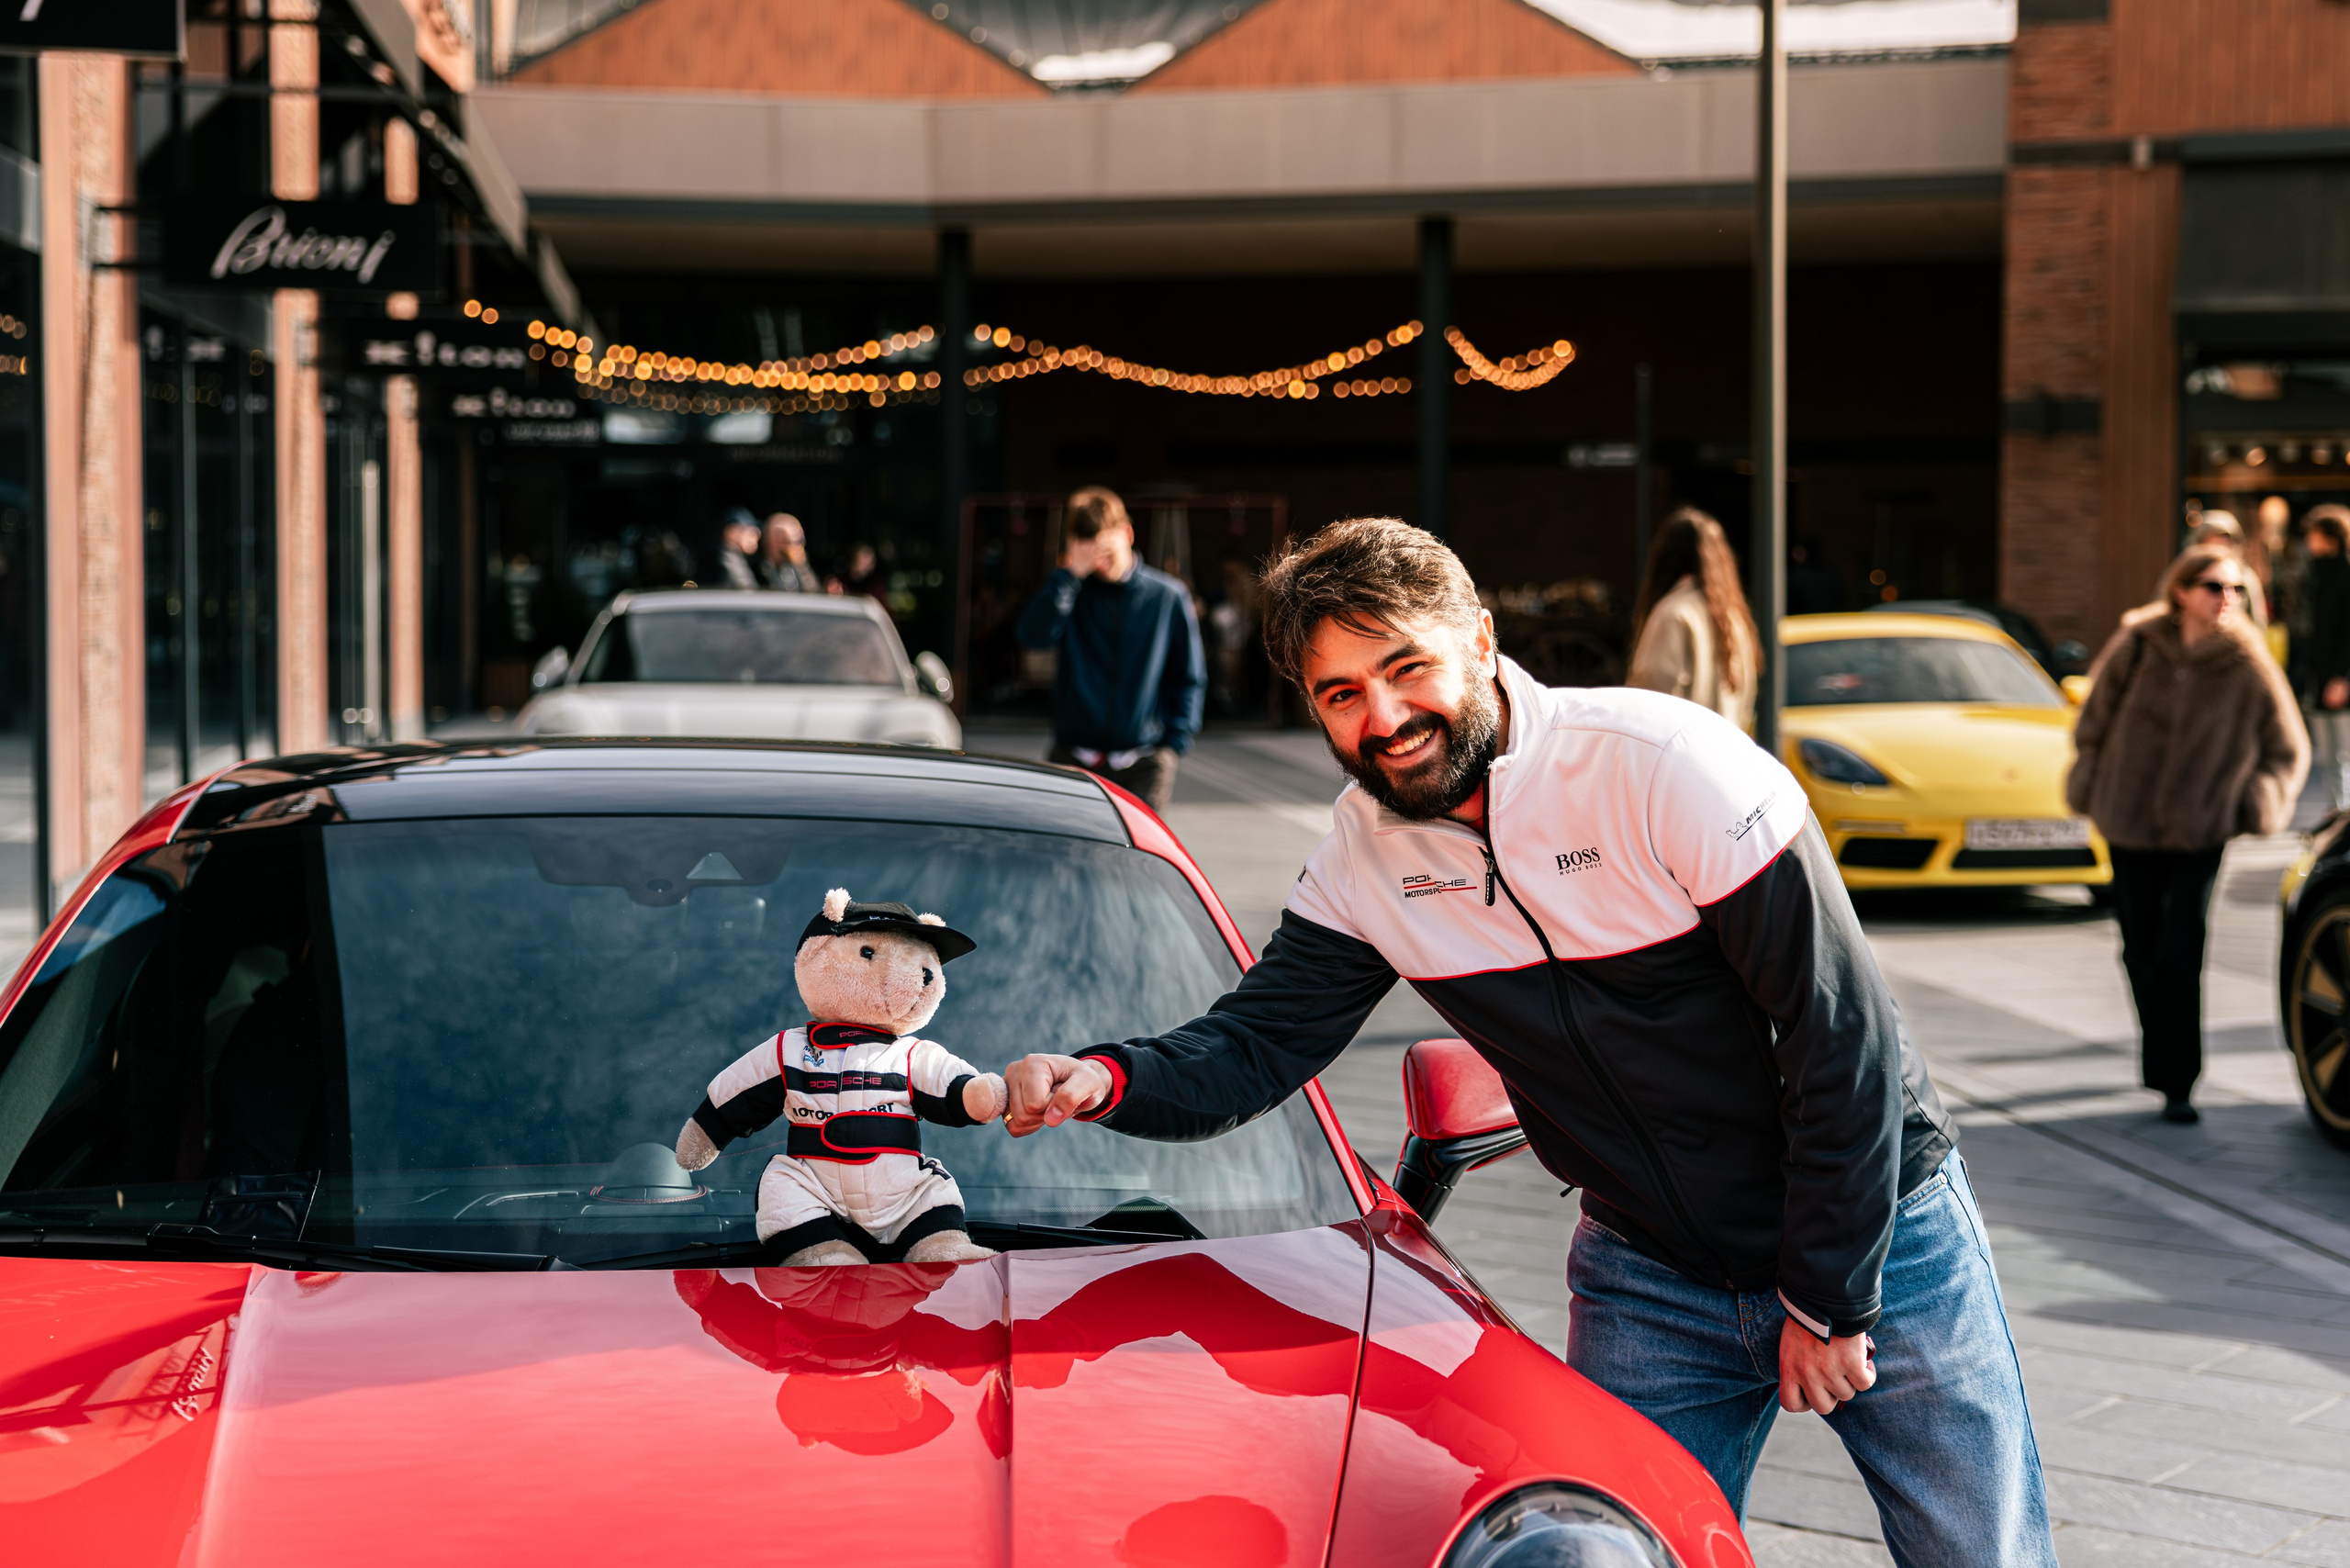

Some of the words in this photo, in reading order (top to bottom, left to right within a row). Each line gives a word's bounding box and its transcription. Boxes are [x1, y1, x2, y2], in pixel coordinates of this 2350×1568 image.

[210, 206, 396, 284] Brioni
[1746, 790, 1776, 824] MICHELIN
[1555, 846, 1601, 870] BOSS
[1559, 866, 1583, 876] HUGO
